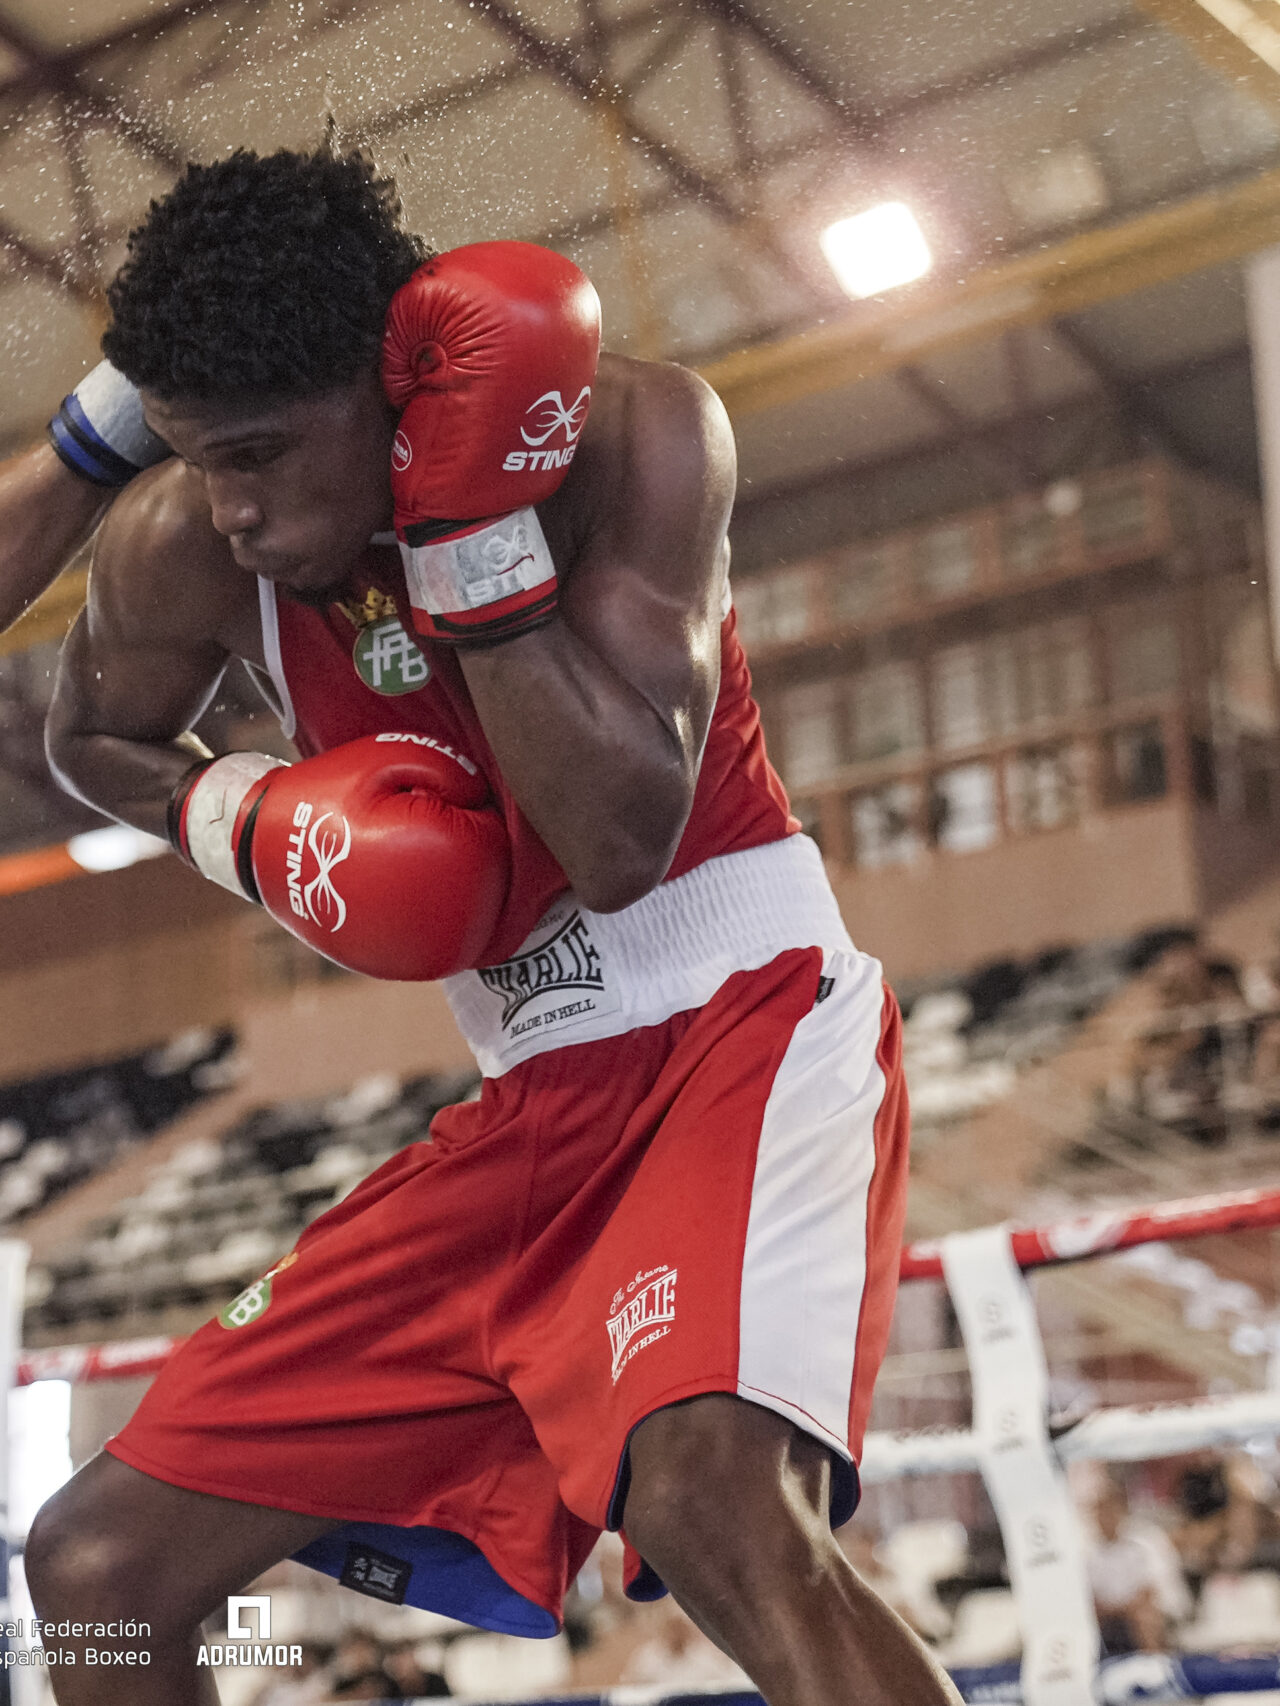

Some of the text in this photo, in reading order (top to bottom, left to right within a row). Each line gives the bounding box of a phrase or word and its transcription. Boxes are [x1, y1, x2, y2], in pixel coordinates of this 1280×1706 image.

[502, 444, 578, 471] STING
[286, 801, 313, 918] STING
[477, 917, 603, 1023] CHARLIE
[509, 998, 596, 1039] MADE IN HELL
